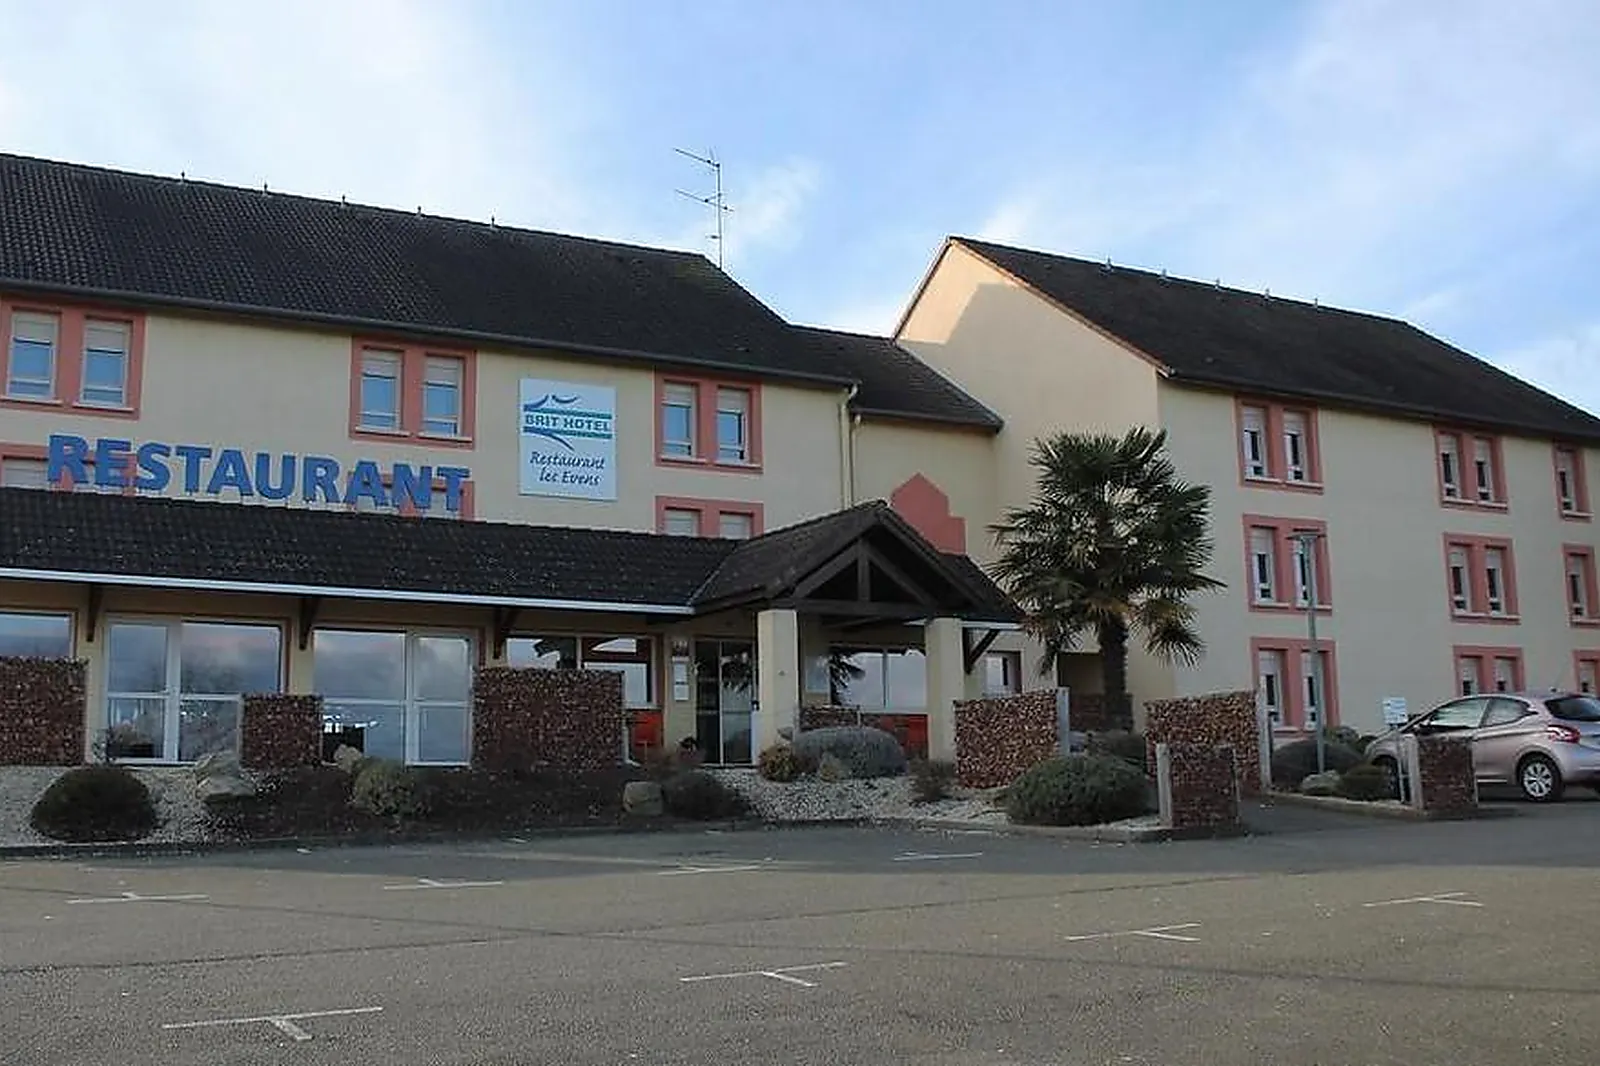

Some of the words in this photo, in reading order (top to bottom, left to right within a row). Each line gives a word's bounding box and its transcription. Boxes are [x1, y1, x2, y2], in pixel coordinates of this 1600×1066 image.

[525, 414, 560, 427] BRIT
[563, 418, 610, 432] HOTEL
[530, 451, 605, 469] Restaurant
[47, 434, 470, 511] RESTAURANT
